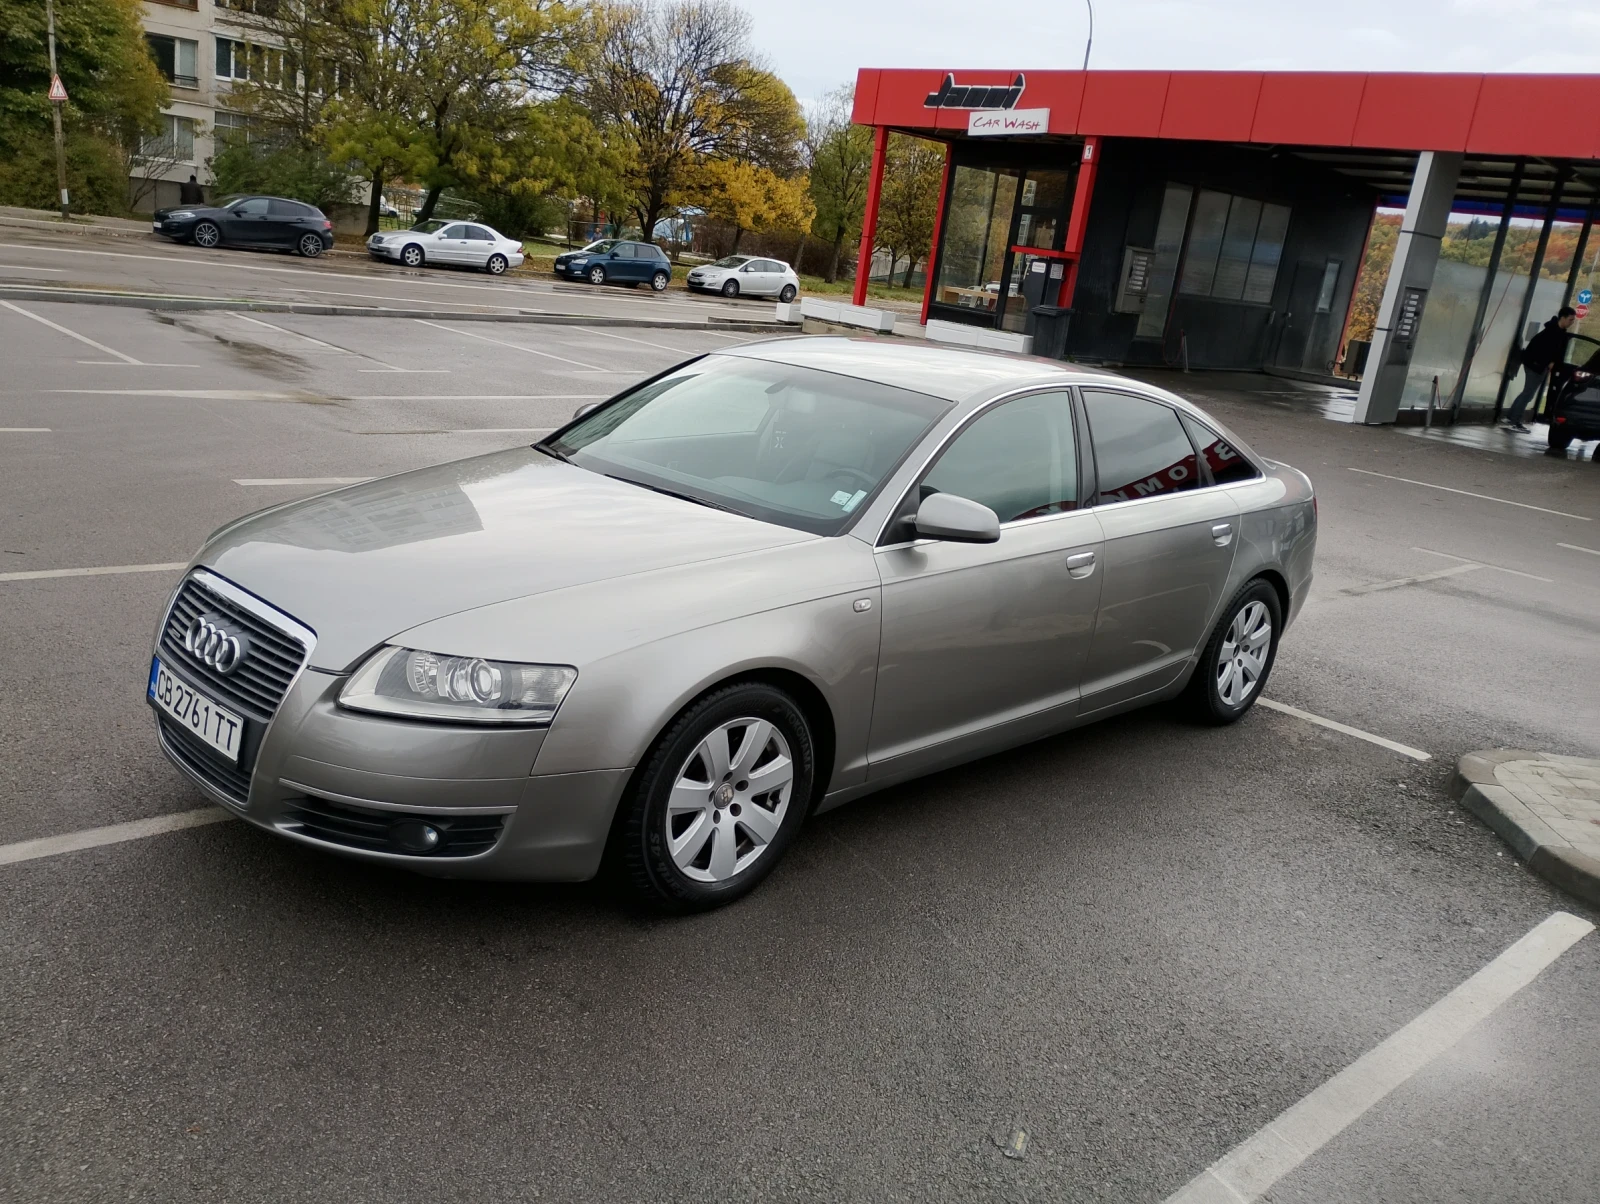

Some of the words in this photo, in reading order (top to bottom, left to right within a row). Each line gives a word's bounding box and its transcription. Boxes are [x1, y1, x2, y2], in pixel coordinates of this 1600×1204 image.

[973, 117, 1000, 128] CAR
[1004, 117, 1041, 130] WASH
[173, 685, 210, 736] 2761
[215, 710, 238, 752] TT
[784, 708, 812, 772] YOKOHAMA
